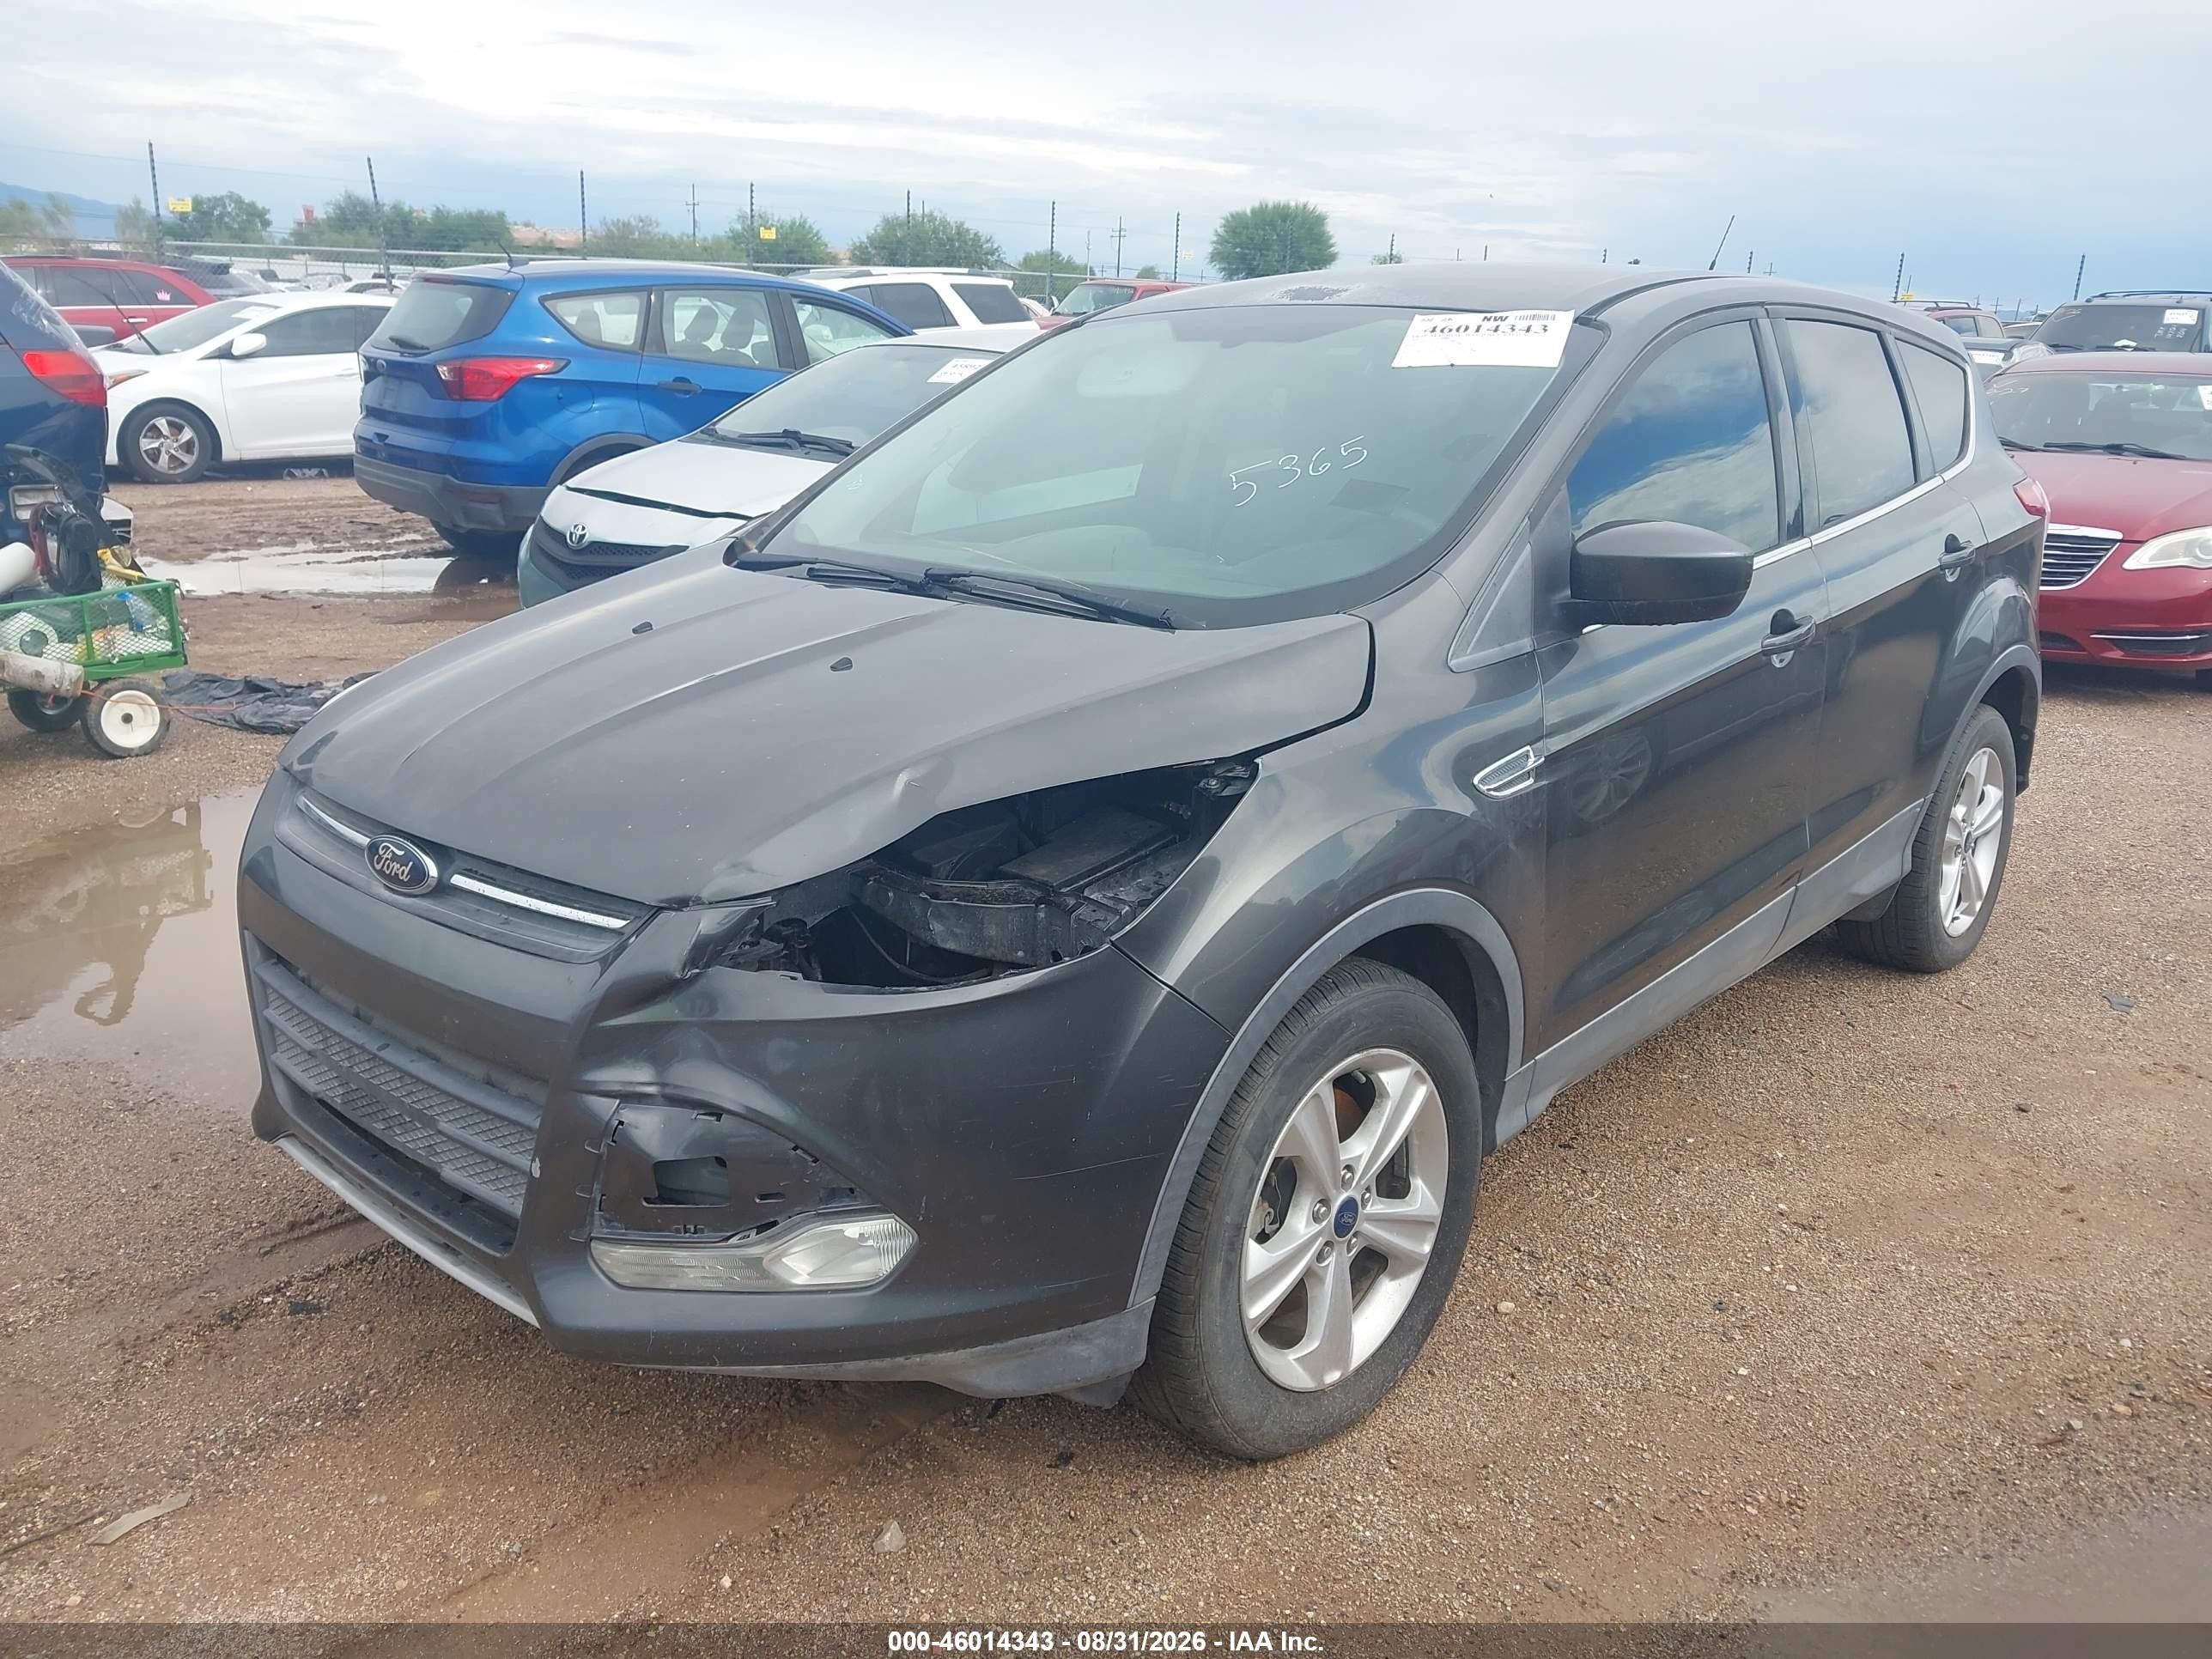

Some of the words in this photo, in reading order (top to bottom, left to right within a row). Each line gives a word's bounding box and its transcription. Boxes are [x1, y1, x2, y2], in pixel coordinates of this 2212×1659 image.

[1423, 324, 1549, 334] 46014343
[1229, 434, 1368, 507] 5365
[374, 842, 413, 882] Ford
